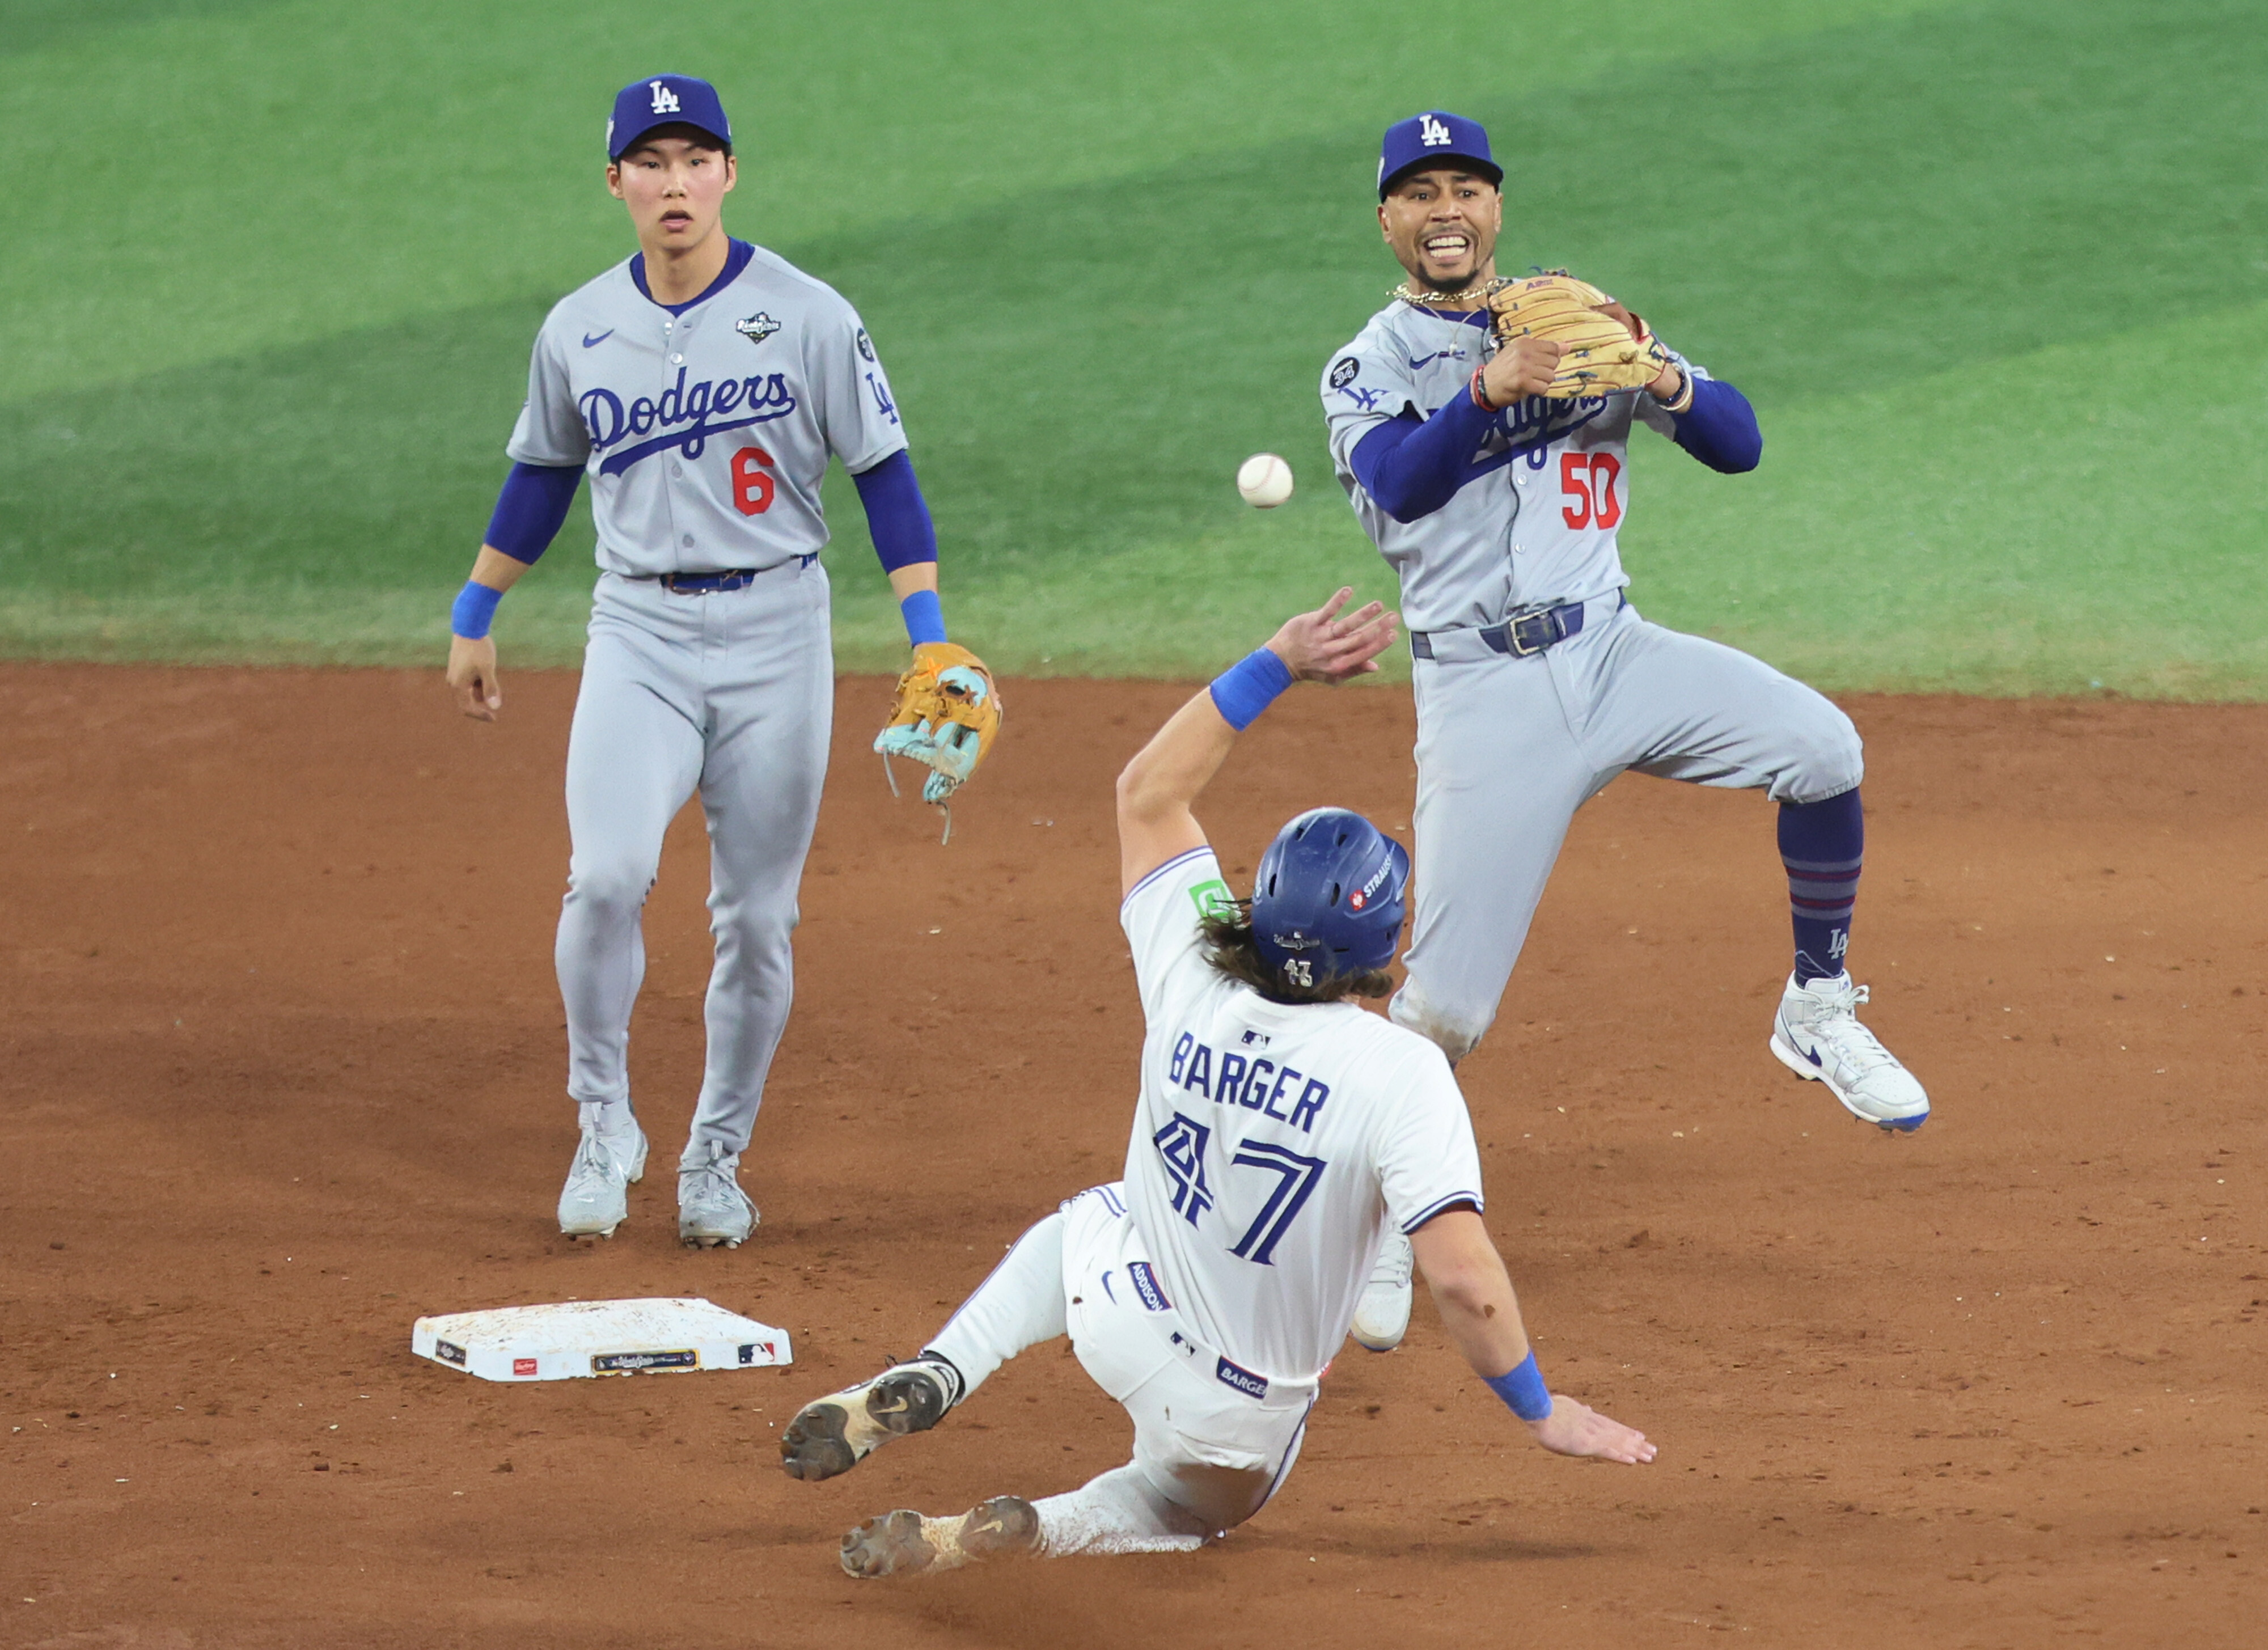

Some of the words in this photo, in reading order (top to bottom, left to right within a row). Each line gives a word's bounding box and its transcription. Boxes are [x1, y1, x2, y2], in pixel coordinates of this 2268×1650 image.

[650, 81, 680, 114] LA
[1419, 115, 1452, 146] LA
[579, 366, 796, 460] Dodgers
[865, 372, 898, 425] LA
[1337, 387, 1391, 412] LA
[730, 446, 775, 517] 6
[1560, 452, 1621, 530] 50
[1363, 853, 1392, 898] STRAUSS
[1827, 928, 1848, 960] LA
[1169, 1031, 1330, 1133] BARGER
[1153, 1111, 1328, 1266] 47
[1133, 1263, 1163, 1311] ADDISON
